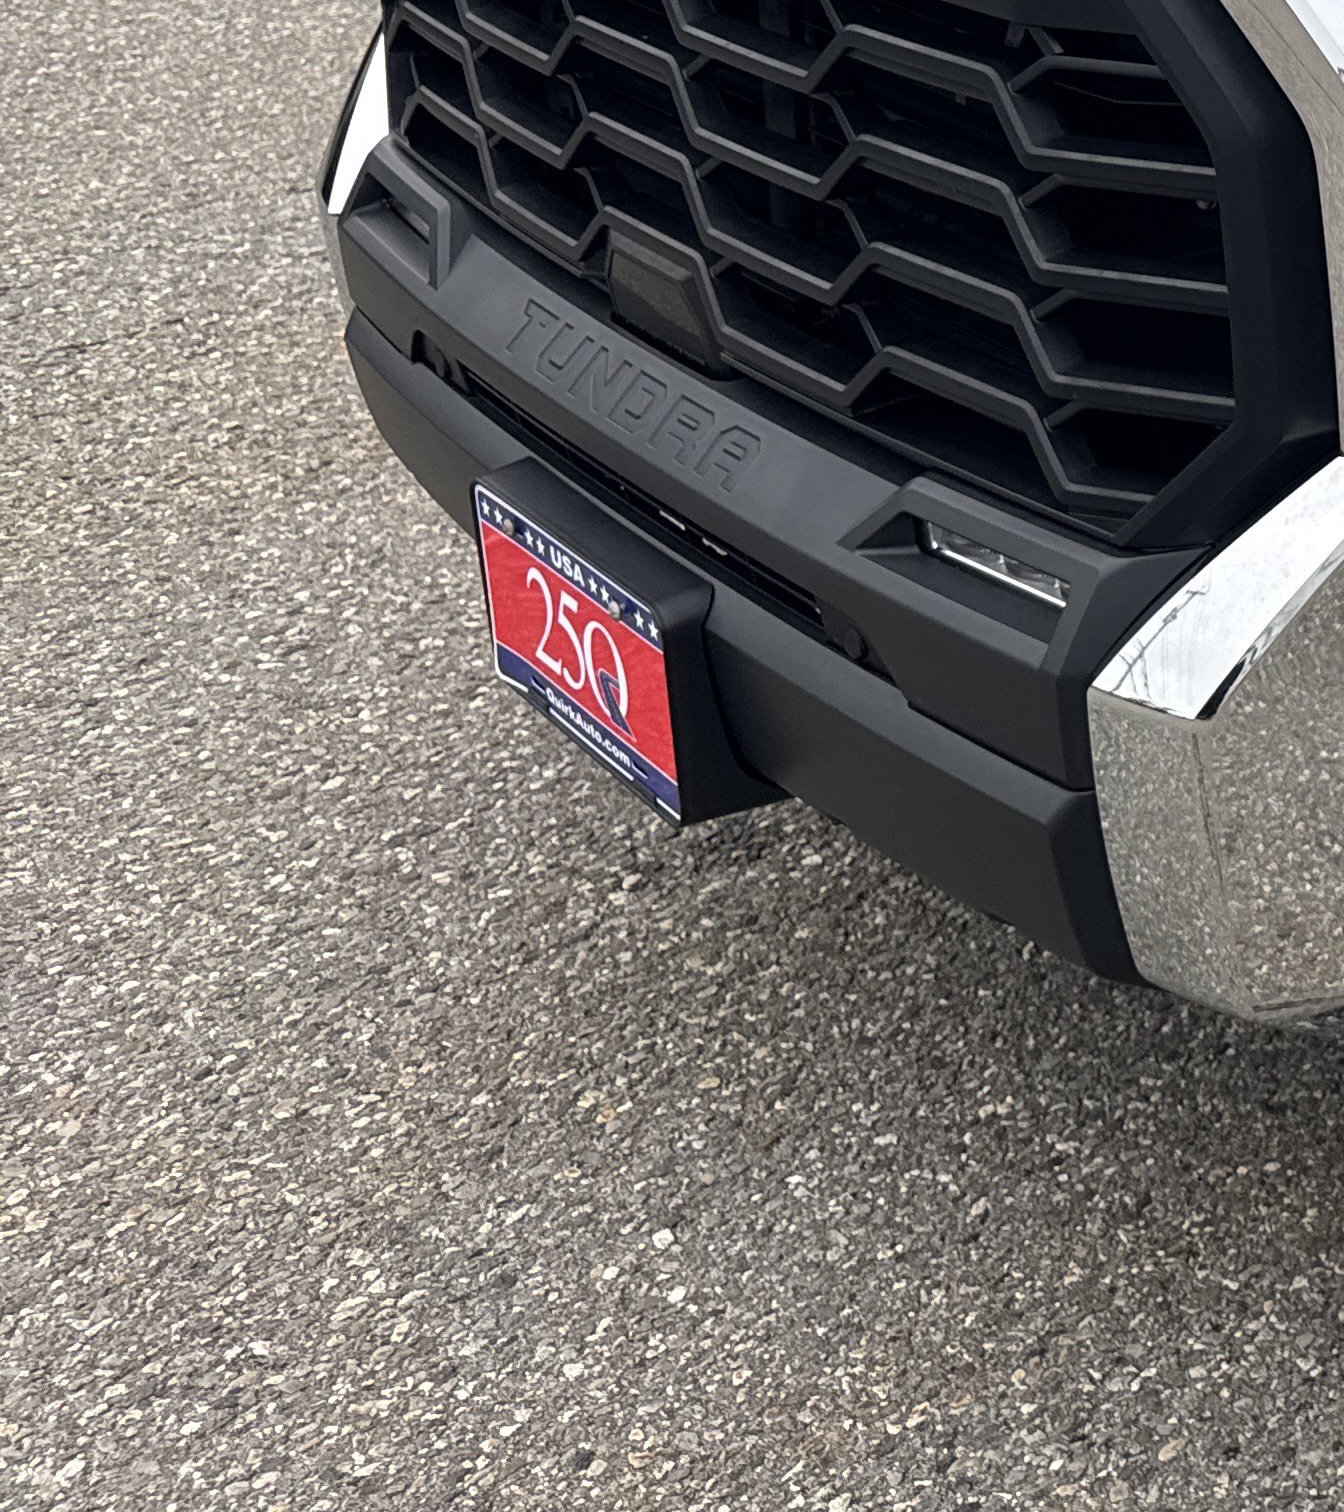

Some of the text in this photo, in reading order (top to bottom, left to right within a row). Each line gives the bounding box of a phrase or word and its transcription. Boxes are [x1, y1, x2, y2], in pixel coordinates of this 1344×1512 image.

[504, 297, 762, 493] TUNDRA
[549, 544, 586, 588] USA
[545, 687, 632, 767] QuirkAuto.com
